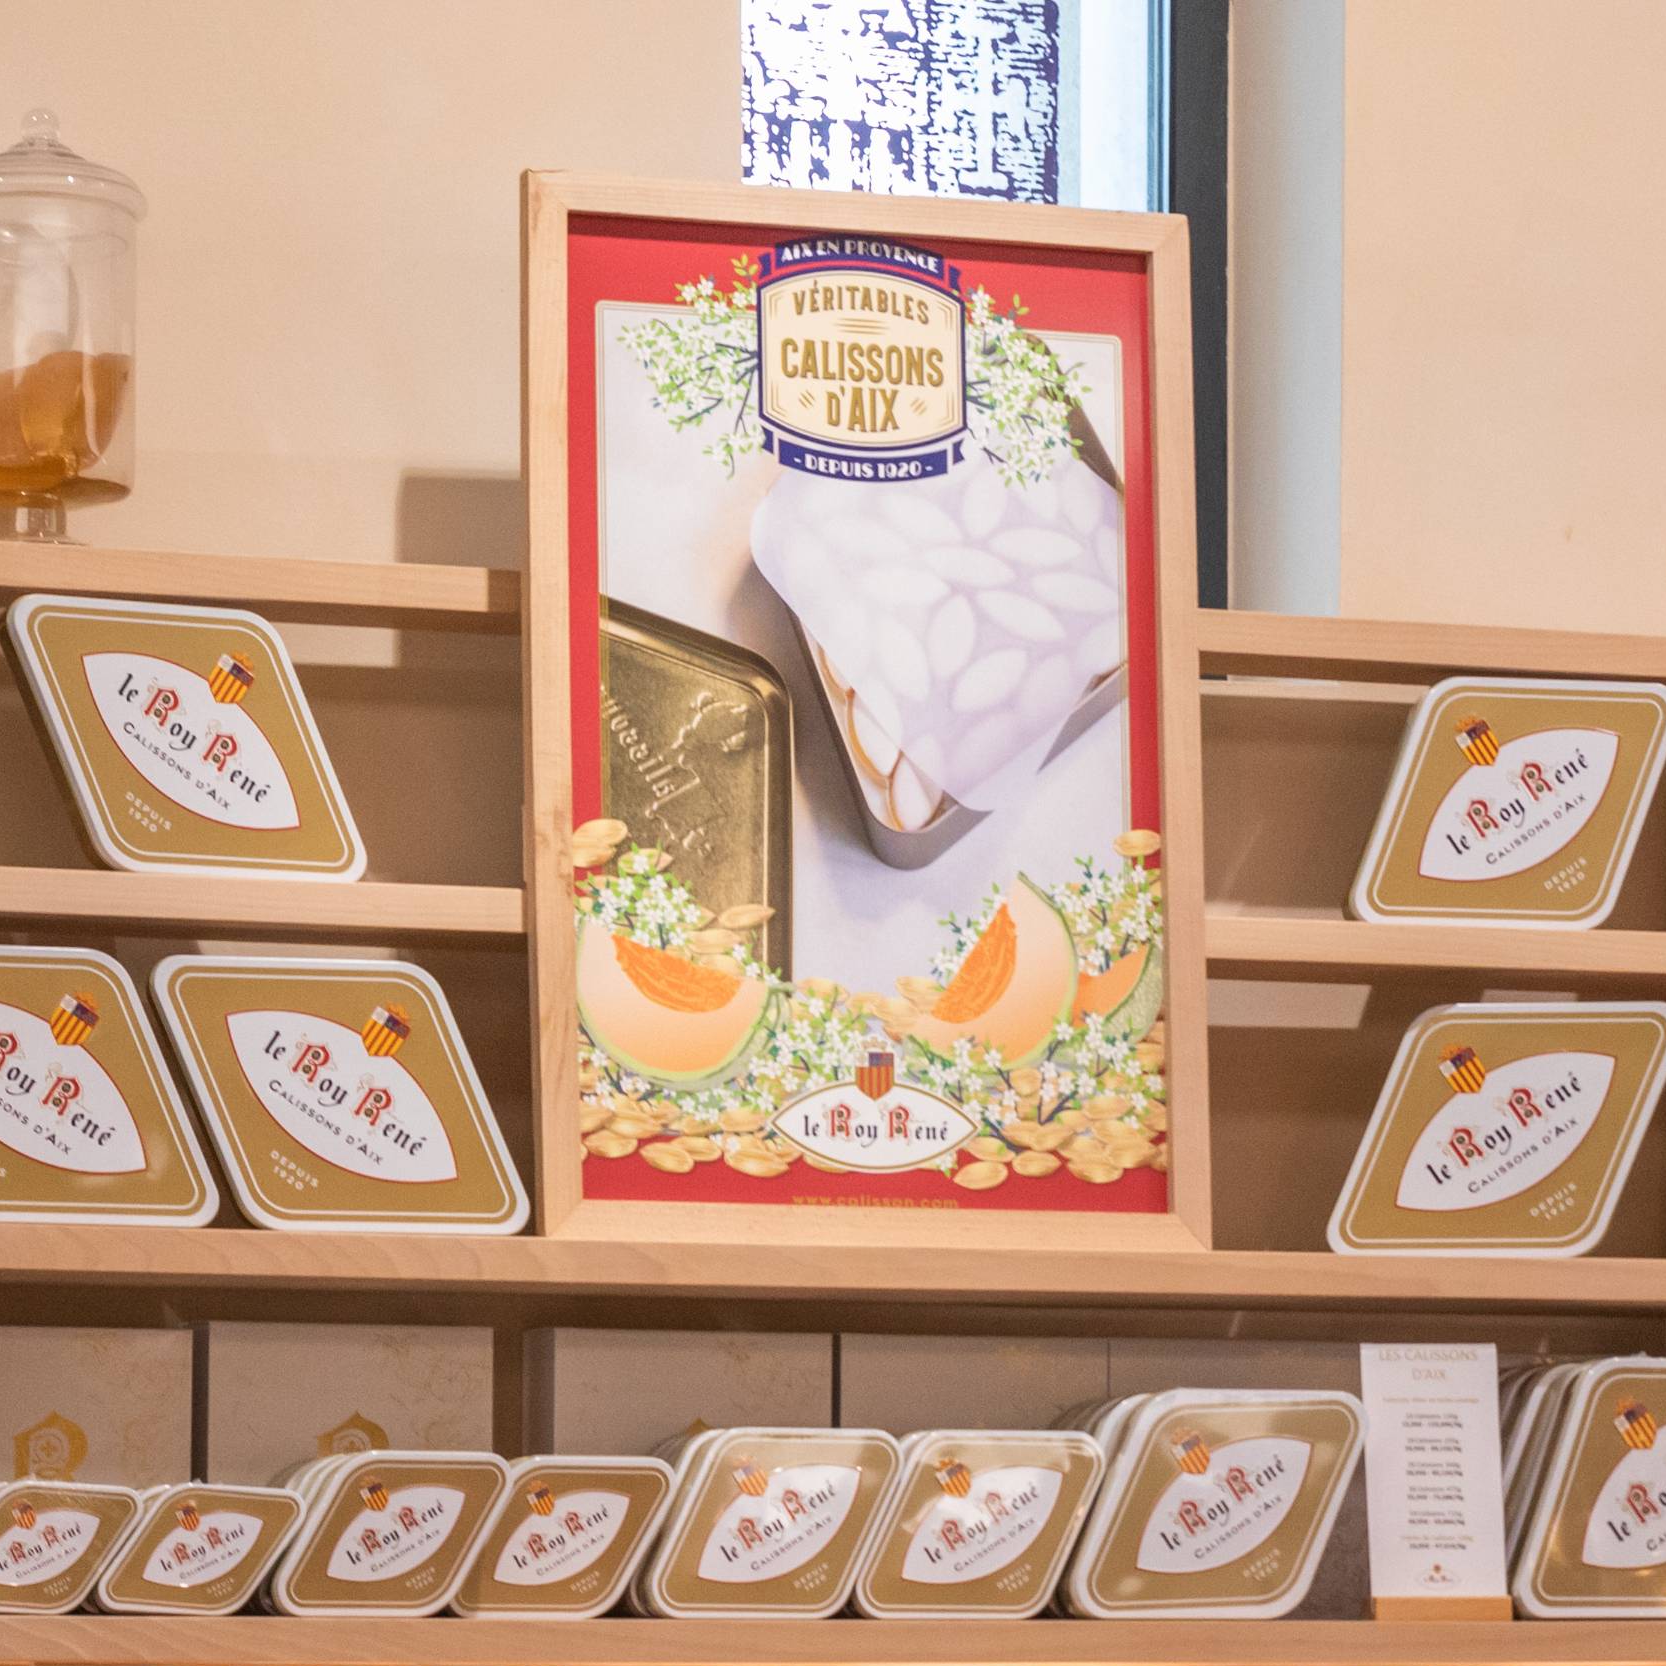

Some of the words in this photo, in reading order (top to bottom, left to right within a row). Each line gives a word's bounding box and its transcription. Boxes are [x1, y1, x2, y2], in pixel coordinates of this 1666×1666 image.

[781, 242, 813, 263] AIX
[817, 240, 841, 256] EN
[844, 239, 939, 273] PROVENCE
[792, 280, 930, 325] VÉRITABLES
[781, 338, 944, 387] CALISSONS
[826, 385, 900, 432] D'AIX
[804, 453, 874, 478] DEPUIS
[877, 461, 922, 478] 1920
[117, 672, 139, 703] le
[142, 687, 197, 751] Roy
[203, 733, 271, 803] René
[1446, 832, 1470, 856] le
[1465, 798, 1526, 839] Roy
[1520, 748, 1589, 802] René
[41, 1076, 116, 1148] René
[264, 1030, 286, 1062] le
[291, 1043, 349, 1107] Roy
[353, 1086, 428, 1156] René
[803, 1115, 820, 1137] le
[823, 1104, 878, 1148] Roy
[887, 1106, 949, 1143] René
[1426, 1161, 1452, 1186] le
[1448, 1126, 1513, 1168] Roy
[1507, 1071, 1582, 1128] René
[1160, 1530, 1182, 1551] le
[1178, 1500, 1230, 1536] Roy
[1225, 1454, 1286, 1502] René
[1606, 1519, 1632, 1542] le
